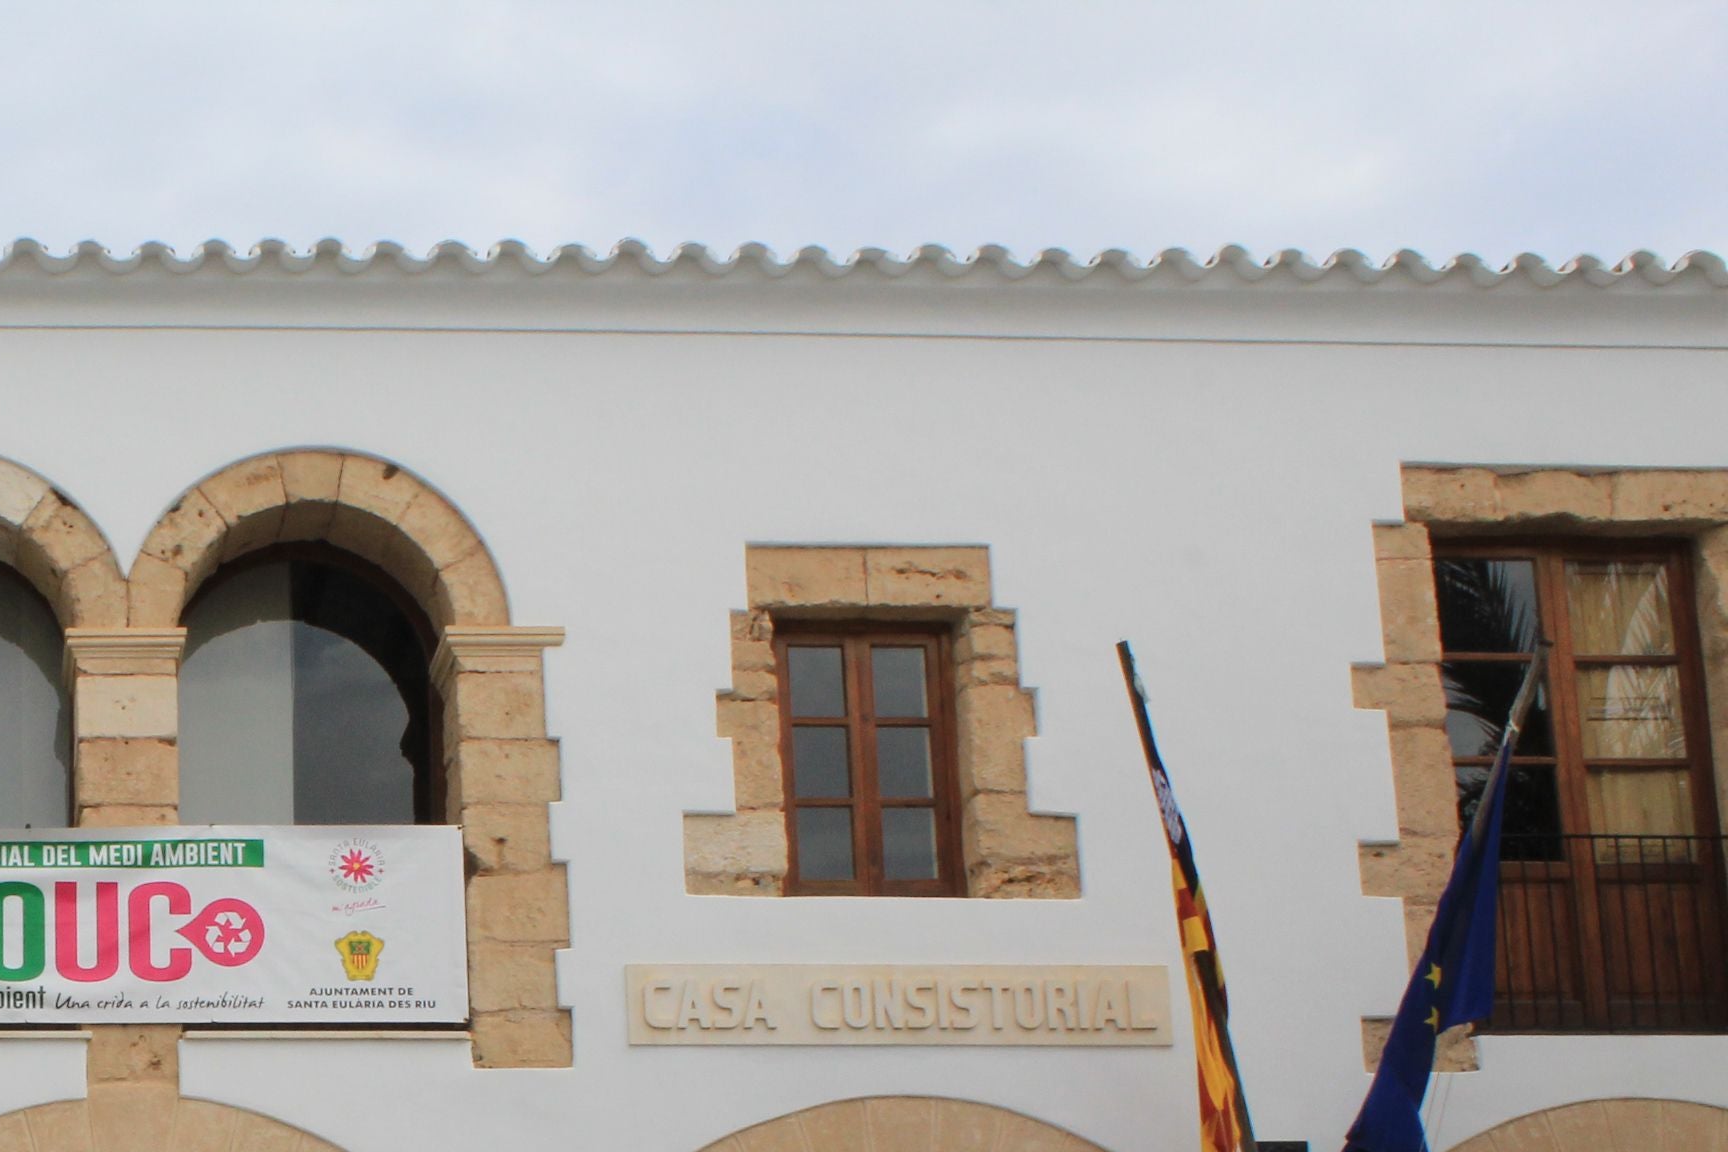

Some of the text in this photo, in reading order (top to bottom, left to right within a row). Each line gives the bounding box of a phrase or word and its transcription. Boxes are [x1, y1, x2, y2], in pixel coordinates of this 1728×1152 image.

[42, 844, 82, 866] DEL
[89, 844, 142, 866] MEDI
[150, 842, 246, 866] AMBIENT
[55, 992, 90, 1009] Una
[96, 991, 133, 1009] crida
[139, 999, 151, 1009] a
[155, 995, 170, 1009] la
[176, 991, 265, 1010] sostenibilitat
[309, 987, 413, 996] AJUNTAMENT DE
[287, 1000, 328, 1009] SANTA
[389, 1000, 411, 1009] DES
[415, 1000, 436, 1009] RIU
[642, 979, 1158, 1030] CASA CONSISTORIAL
